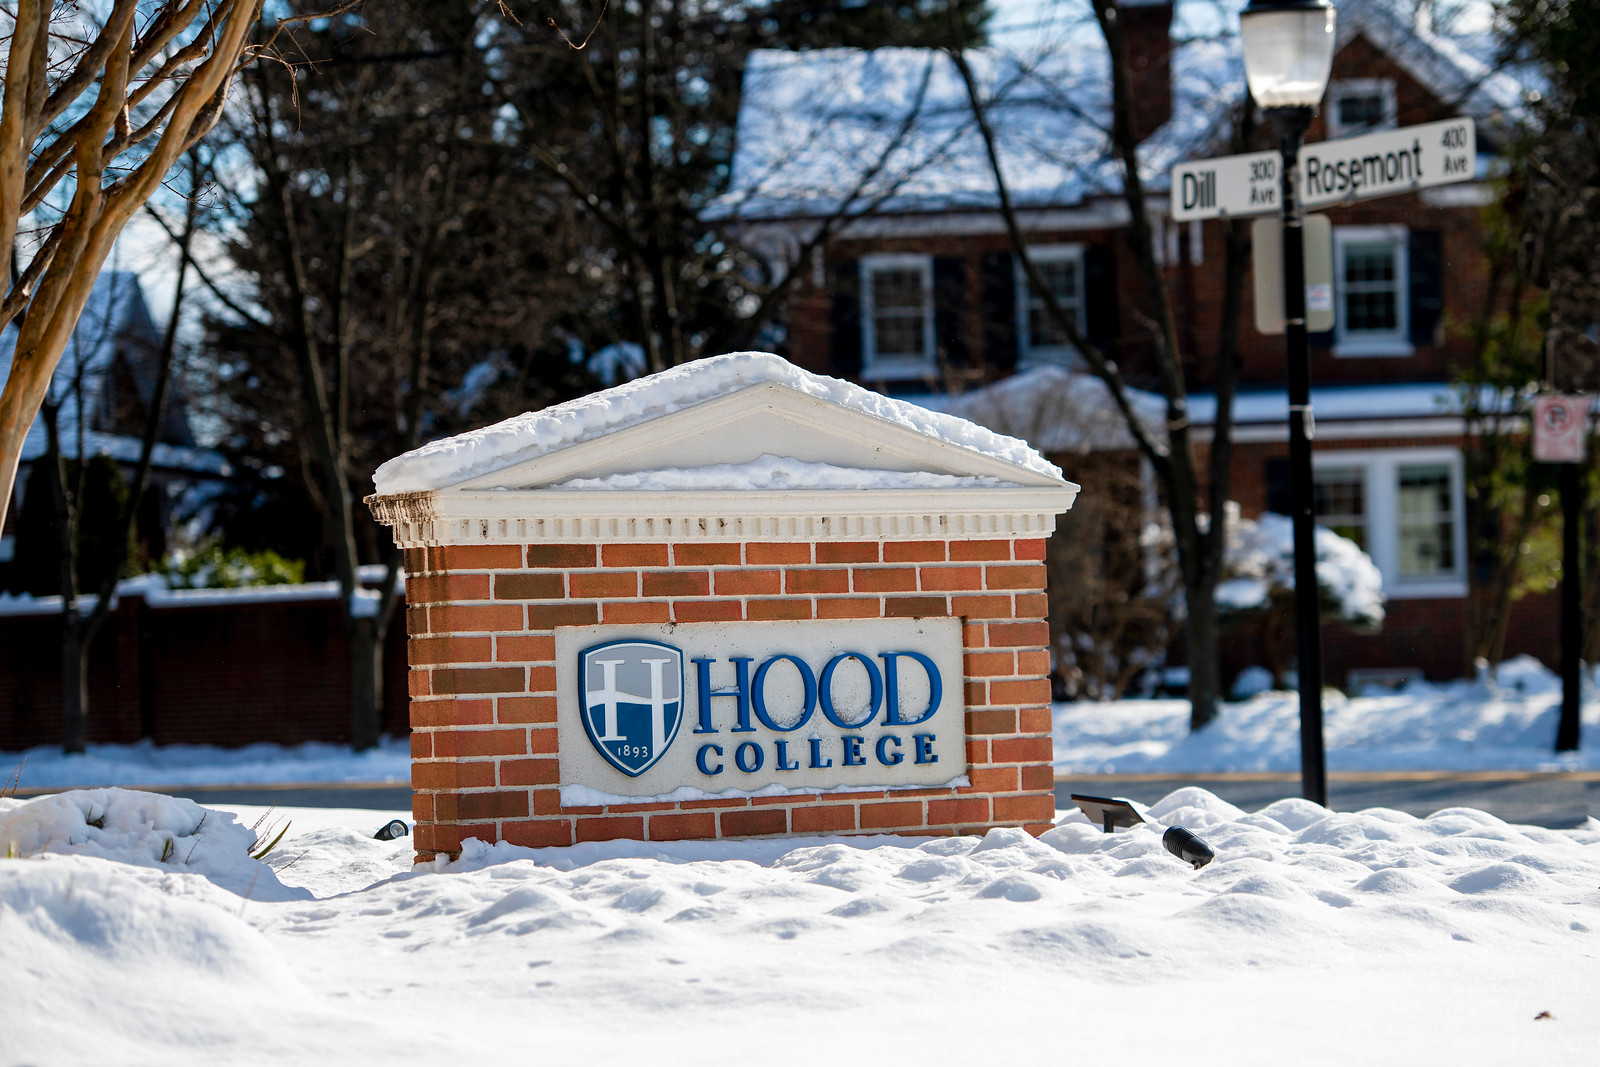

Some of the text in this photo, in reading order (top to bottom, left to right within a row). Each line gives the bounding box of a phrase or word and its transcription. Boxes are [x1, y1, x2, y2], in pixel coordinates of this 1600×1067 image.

[1441, 126, 1467, 149] 400
[1249, 160, 1274, 182] 300
[1307, 139, 1423, 195] Rosemont
[1443, 155, 1468, 174] Ave
[1182, 170, 1216, 210] Dill
[1250, 187, 1275, 205] Ave
[691, 650, 943, 733] HOOD
[616, 743, 649, 759] 1893
[695, 733, 939, 776] COLLEGE
